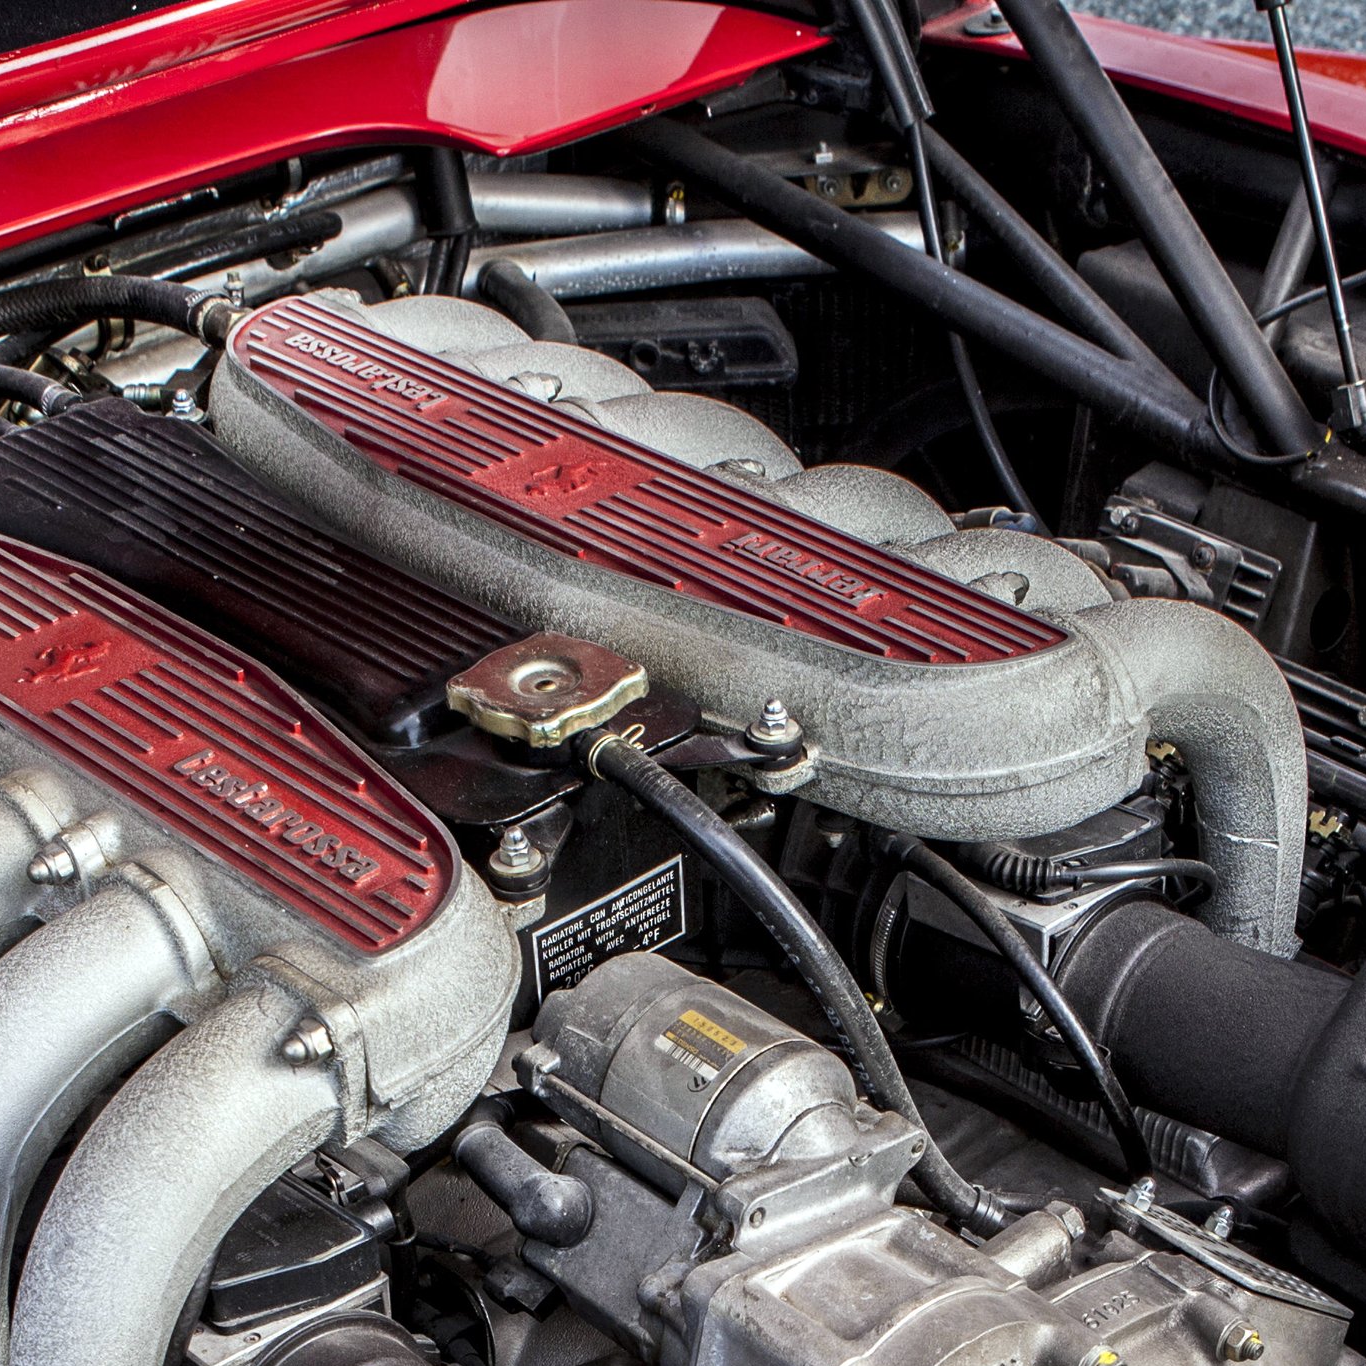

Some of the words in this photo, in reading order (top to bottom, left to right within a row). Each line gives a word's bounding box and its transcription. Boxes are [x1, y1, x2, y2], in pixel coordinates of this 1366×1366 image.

[285, 332, 449, 411] testarossa
[720, 532, 889, 608] Ferrari
[173, 748, 380, 884] testarossa
[541, 920, 584, 948] RADIATORE
[589, 910, 606, 923] CON
[611, 870, 675, 913] ANTICONGELANTE
[548, 945, 585, 970] RADIATOR
[595, 930, 615, 946] WITH
[624, 898, 671, 930] ANTIFREEZE
[549, 952, 593, 981] RADIATEUR
[606, 934, 625, 951] AVEC
[637, 909, 671, 934] ANTIGEL
[577, 928, 592, 943] MIT
[596, 883, 675, 932] FROSTSCHUTZMITTEL
